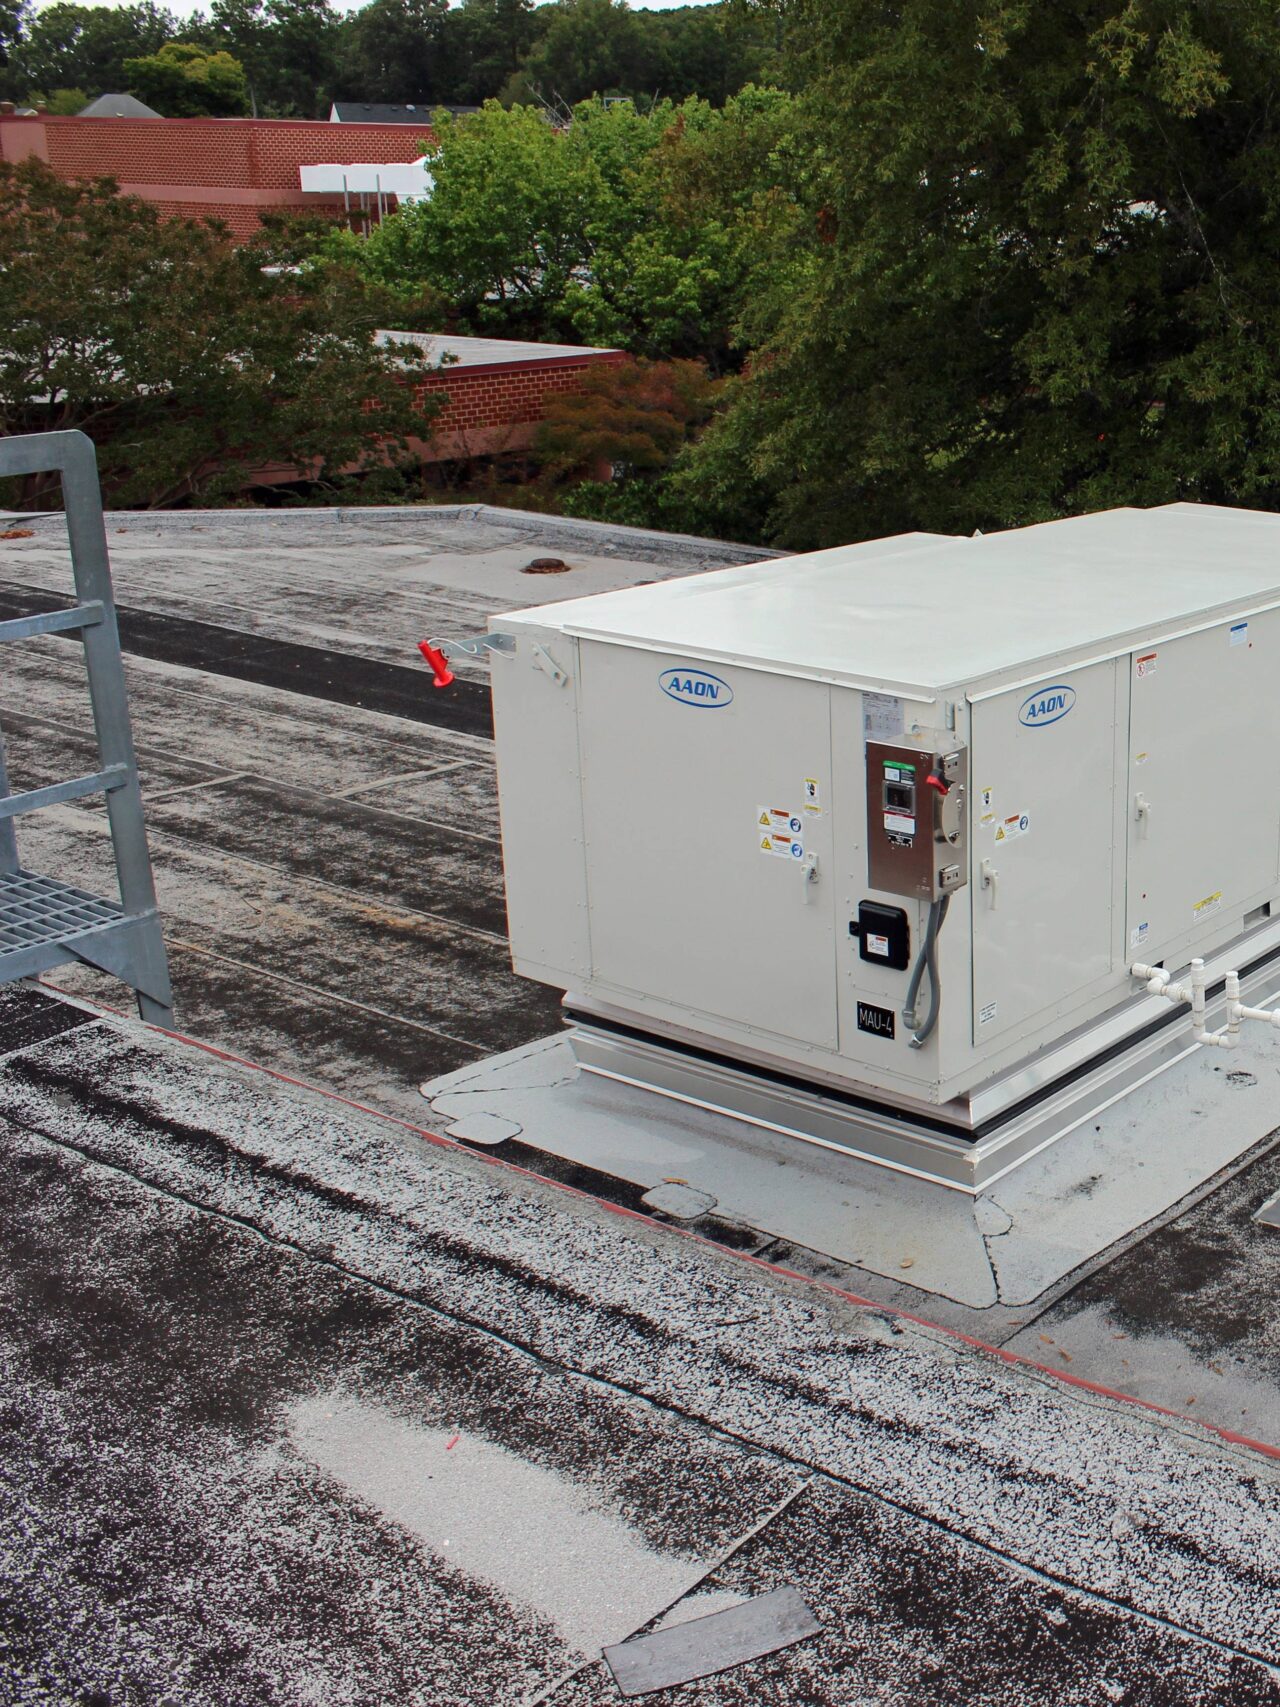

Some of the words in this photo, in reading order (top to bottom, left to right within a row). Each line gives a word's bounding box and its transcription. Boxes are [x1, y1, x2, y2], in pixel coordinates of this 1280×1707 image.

[668, 677, 719, 699] AAON
[1026, 694, 1066, 720] AAON
[859, 1008, 892, 1032] MAU-4
